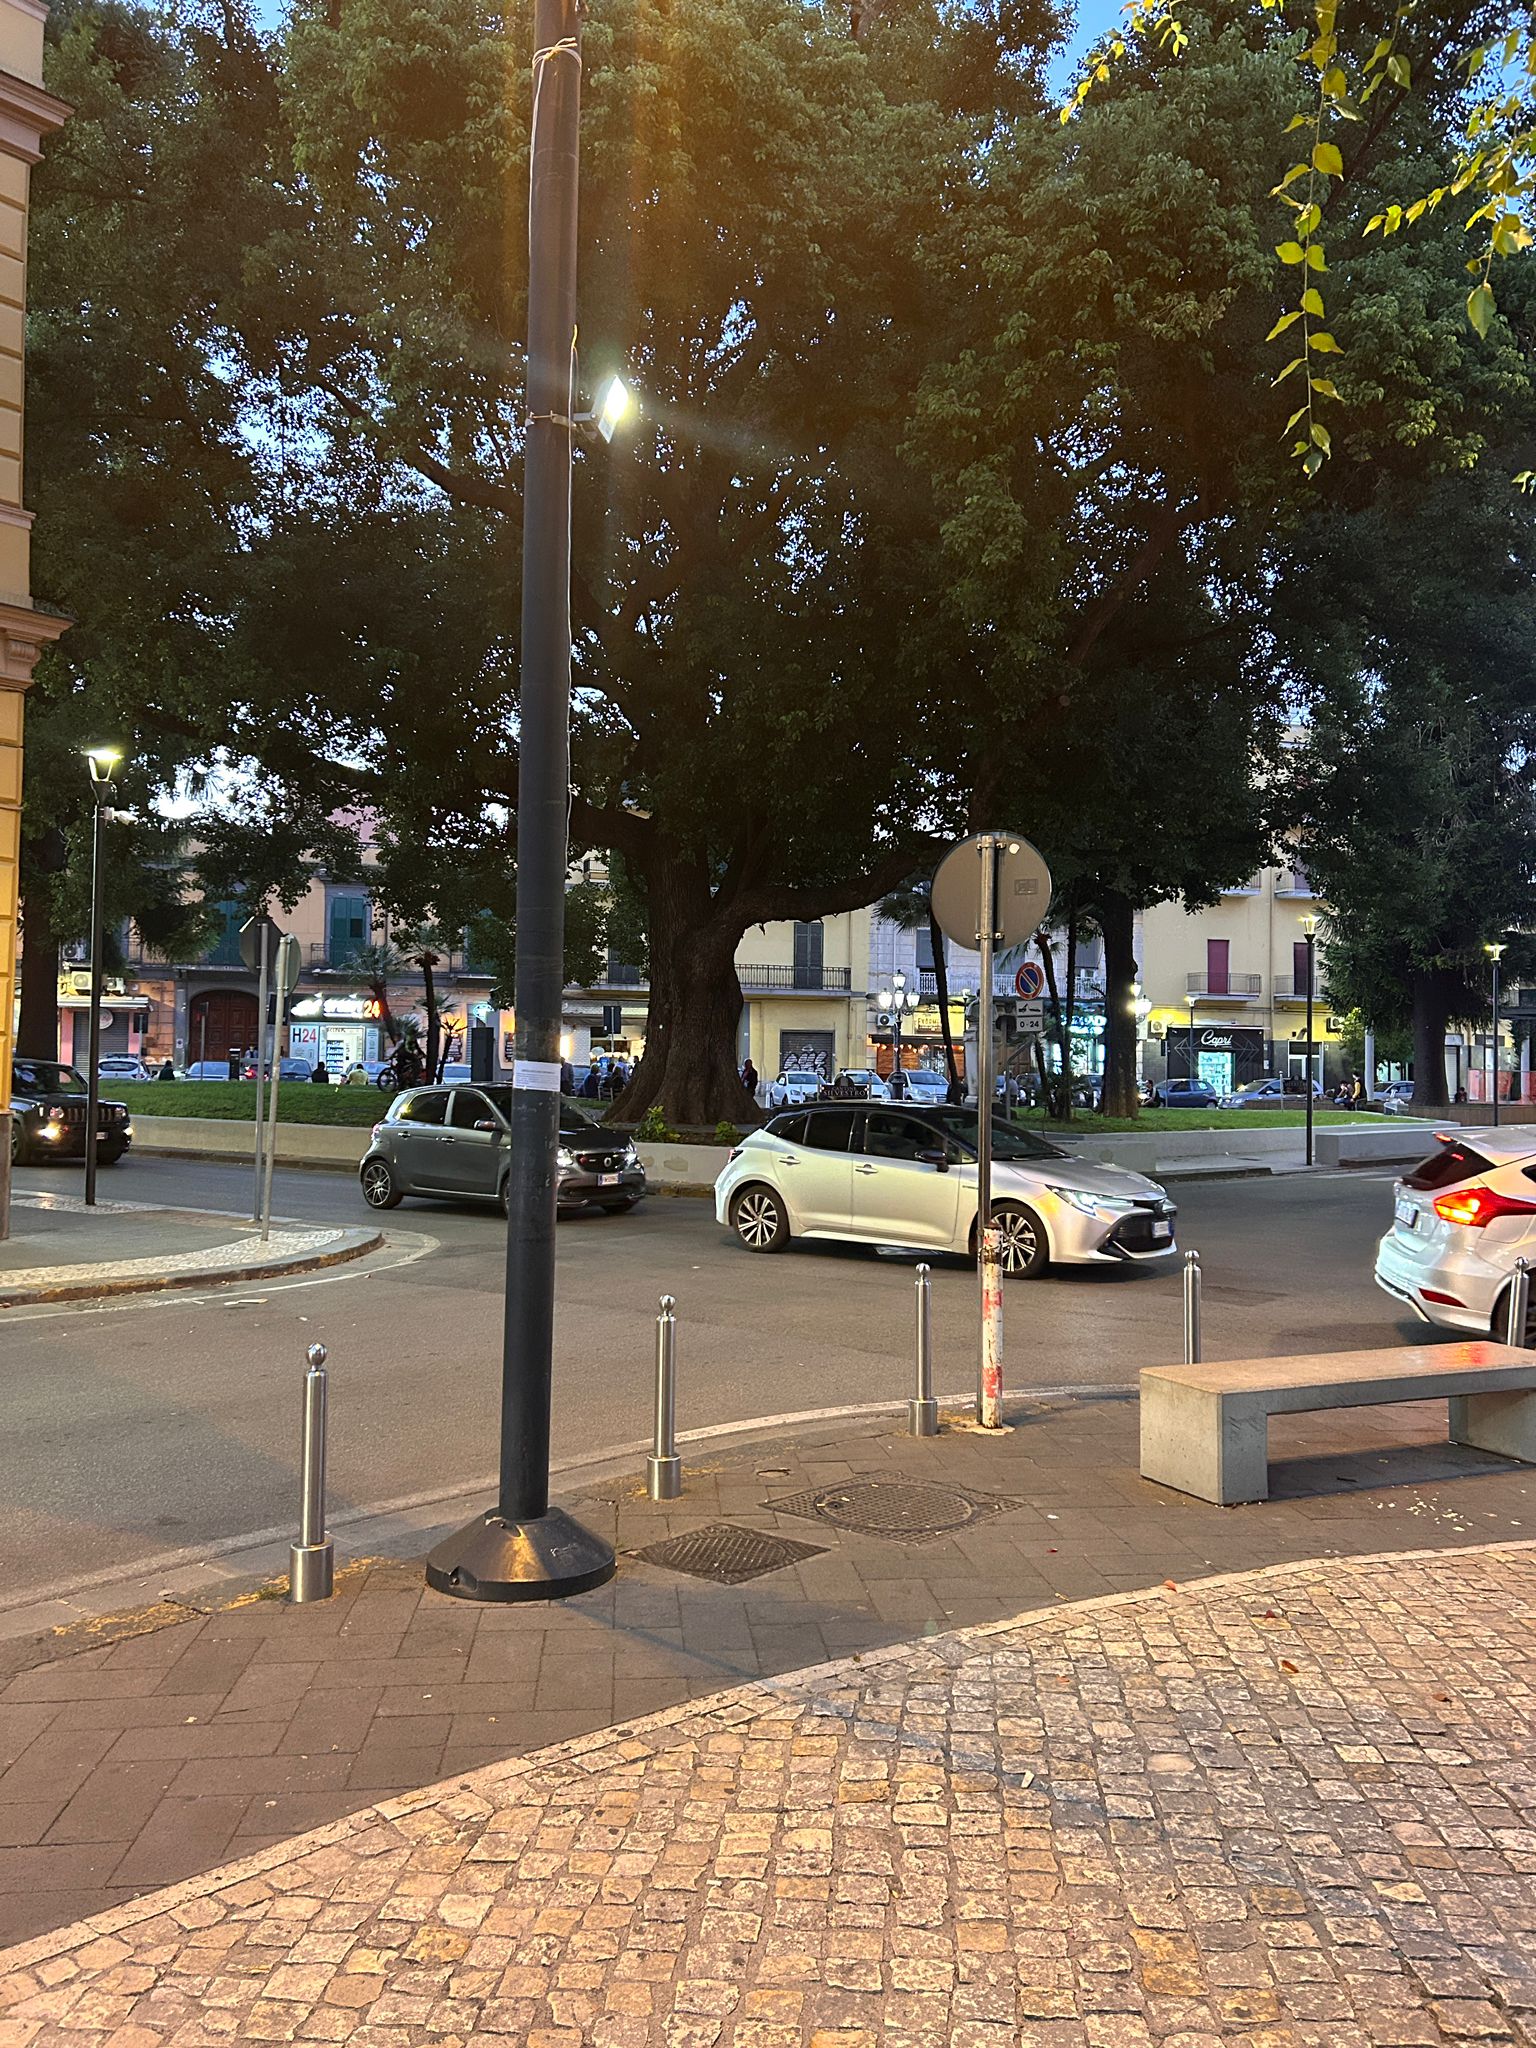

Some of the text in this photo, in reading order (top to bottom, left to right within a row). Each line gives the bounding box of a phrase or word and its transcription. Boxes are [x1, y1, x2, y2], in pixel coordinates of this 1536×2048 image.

[363, 1000, 380, 1018] 24
[292, 1027, 317, 1043] H24
[1200, 1029, 1233, 1047] Capri
